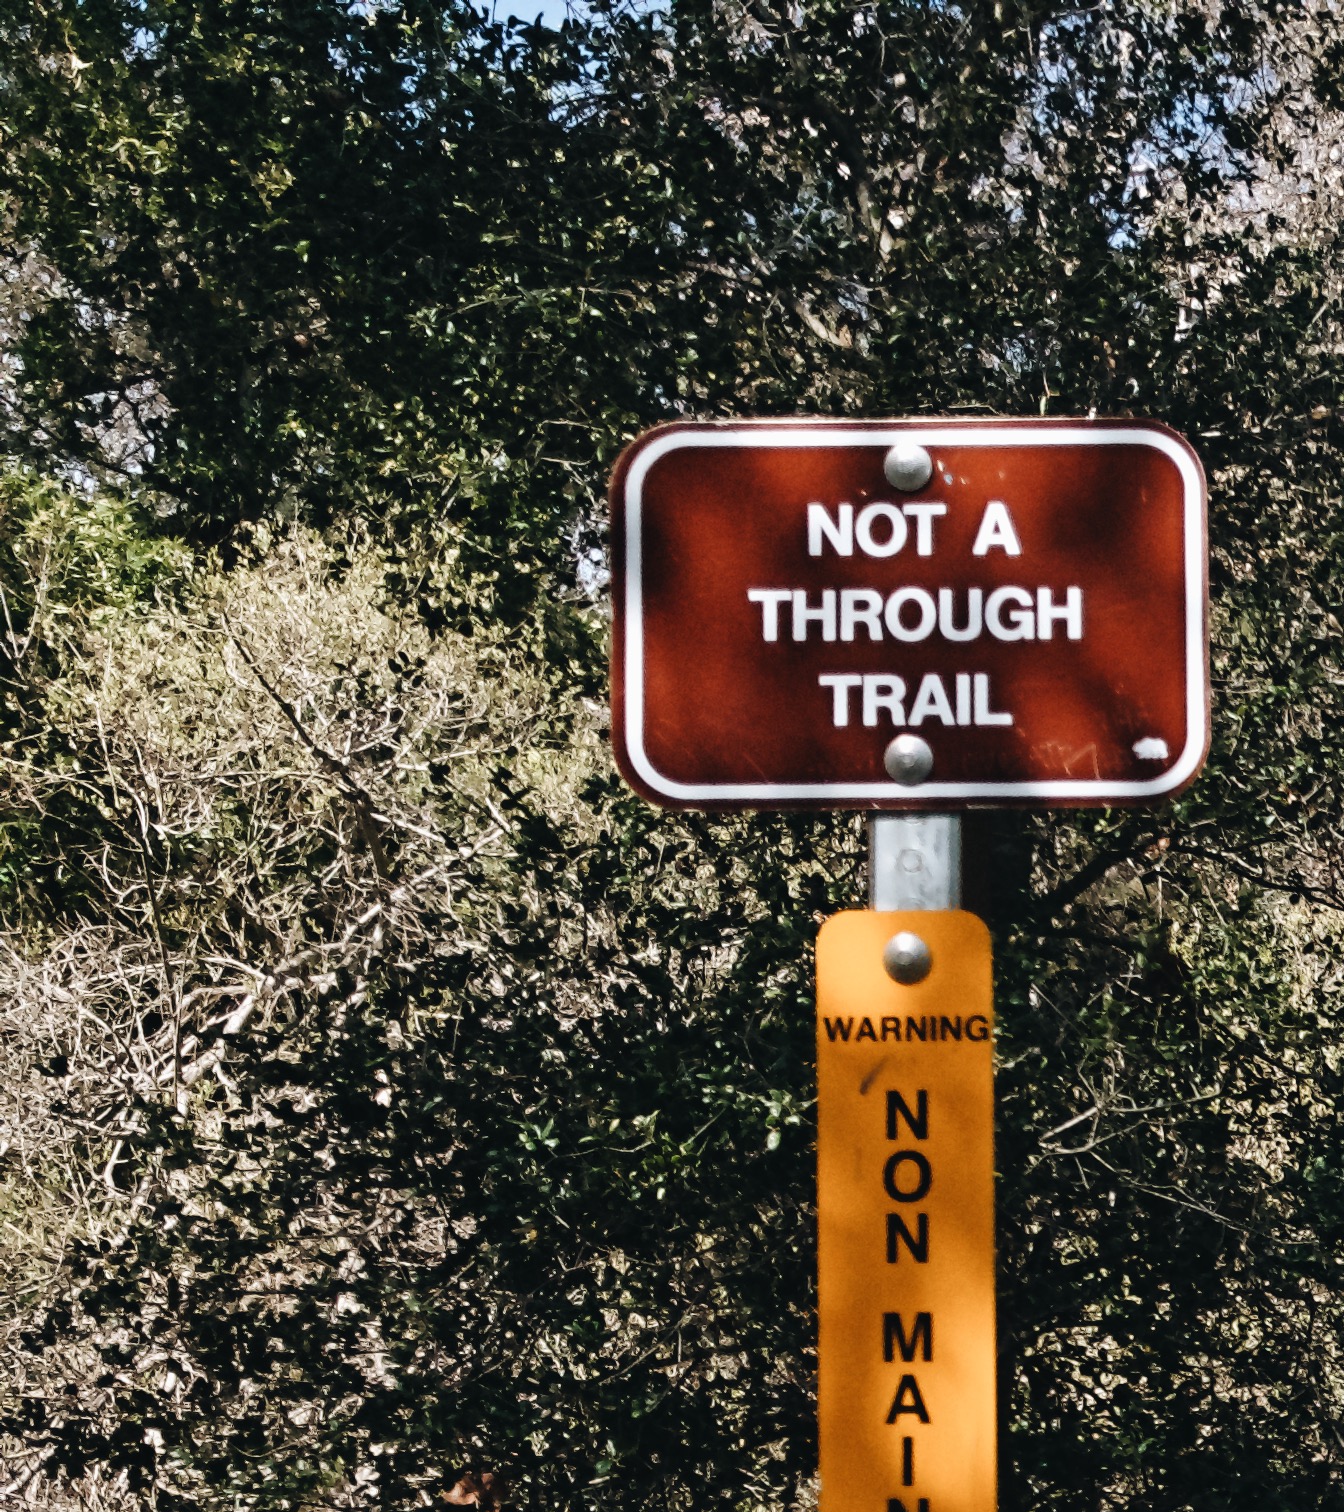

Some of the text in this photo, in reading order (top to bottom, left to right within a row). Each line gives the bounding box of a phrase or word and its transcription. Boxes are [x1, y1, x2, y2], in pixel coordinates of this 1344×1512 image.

[808, 501, 1022, 557] NOT A
[747, 586, 1085, 643] THROUGH
[818, 672, 1014, 728] TRAIL
[823, 1015, 990, 1043] WARNING
[882, 1089, 933, 1265] NON
